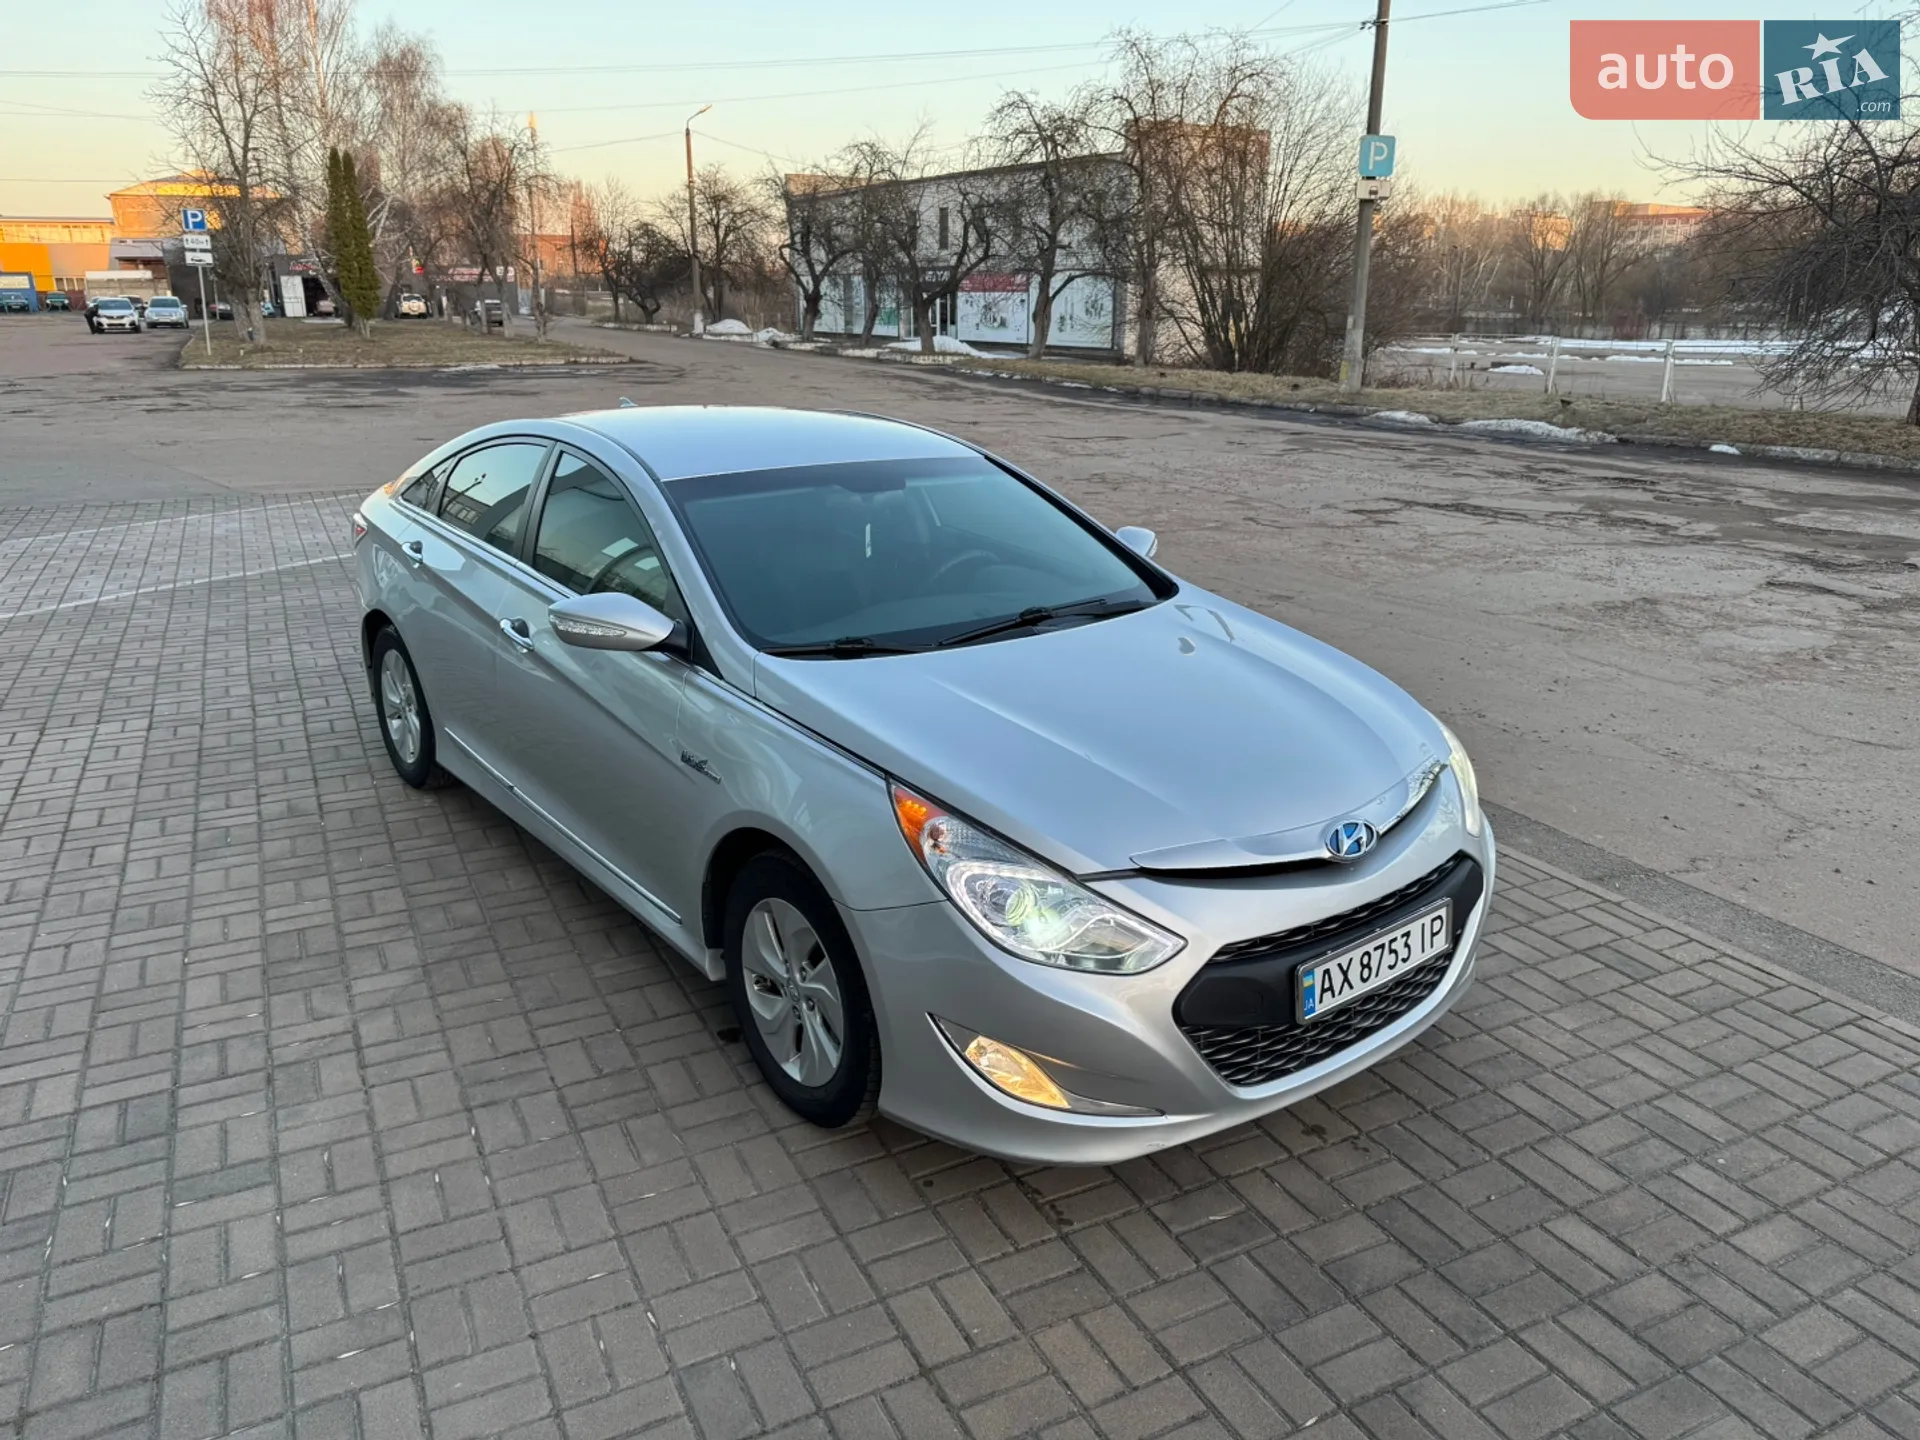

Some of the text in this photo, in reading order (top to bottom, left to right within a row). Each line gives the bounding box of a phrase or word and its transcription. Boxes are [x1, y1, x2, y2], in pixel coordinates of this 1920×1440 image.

[1368, 141, 1388, 171] P
[186, 210, 203, 230] P
[1318, 914, 1444, 1004] AX 8753 IP
